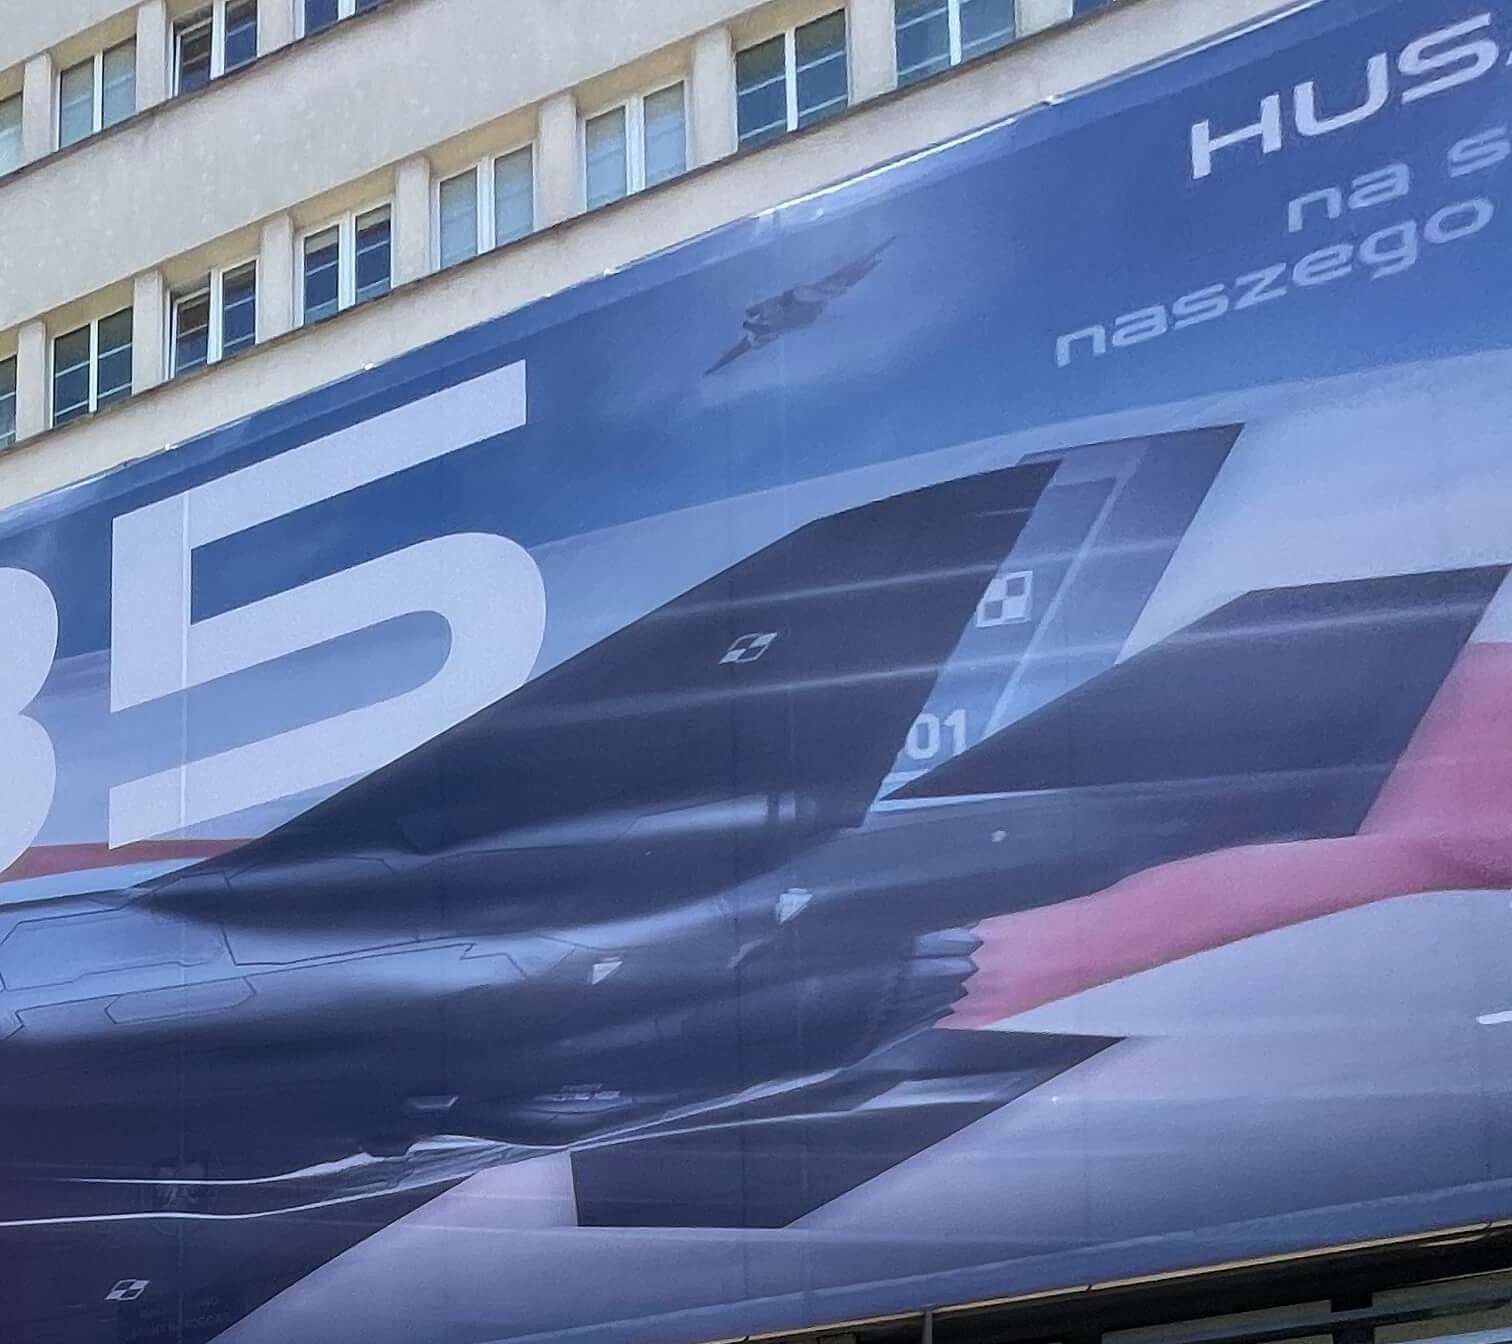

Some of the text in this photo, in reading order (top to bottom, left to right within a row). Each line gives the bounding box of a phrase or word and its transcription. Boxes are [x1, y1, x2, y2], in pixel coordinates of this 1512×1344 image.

[1191, 13, 1512, 179] HUS
[1288, 162, 1410, 233] na
[1055, 197, 1494, 368] naszego
[904, 708, 968, 760] 01
